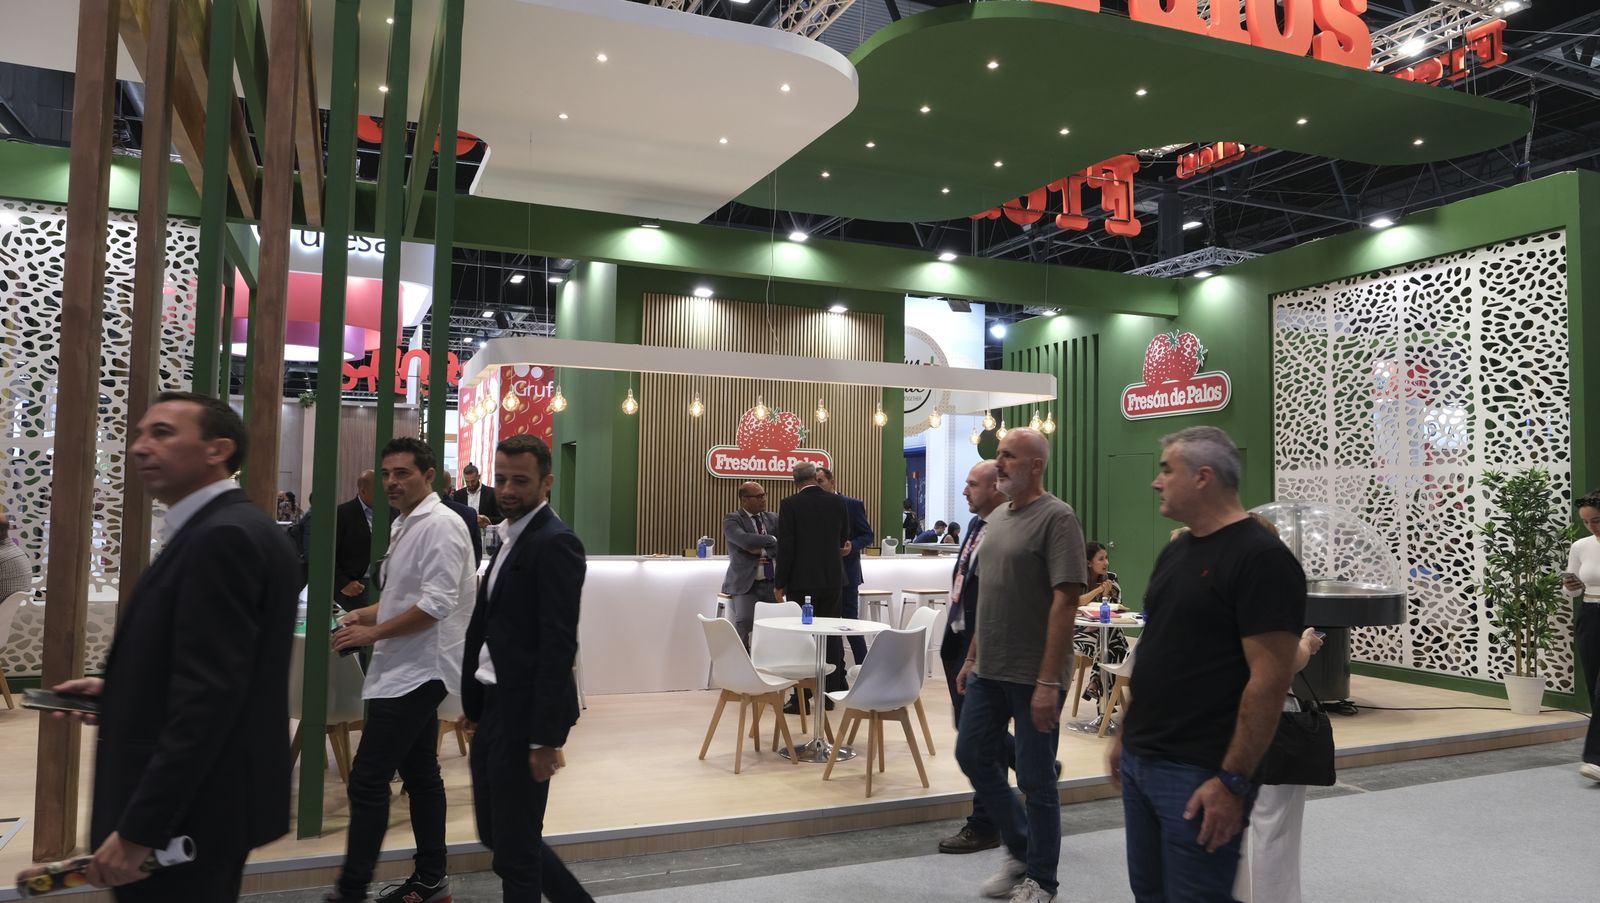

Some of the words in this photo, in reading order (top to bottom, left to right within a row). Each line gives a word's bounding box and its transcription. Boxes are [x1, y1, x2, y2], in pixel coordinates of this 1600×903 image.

[1127, 390, 1169, 411] Fresón
[1170, 387, 1186, 406] de
[1186, 384, 1223, 404] Palos
[715, 454, 767, 471] Fresón
[768, 455, 786, 472] de
